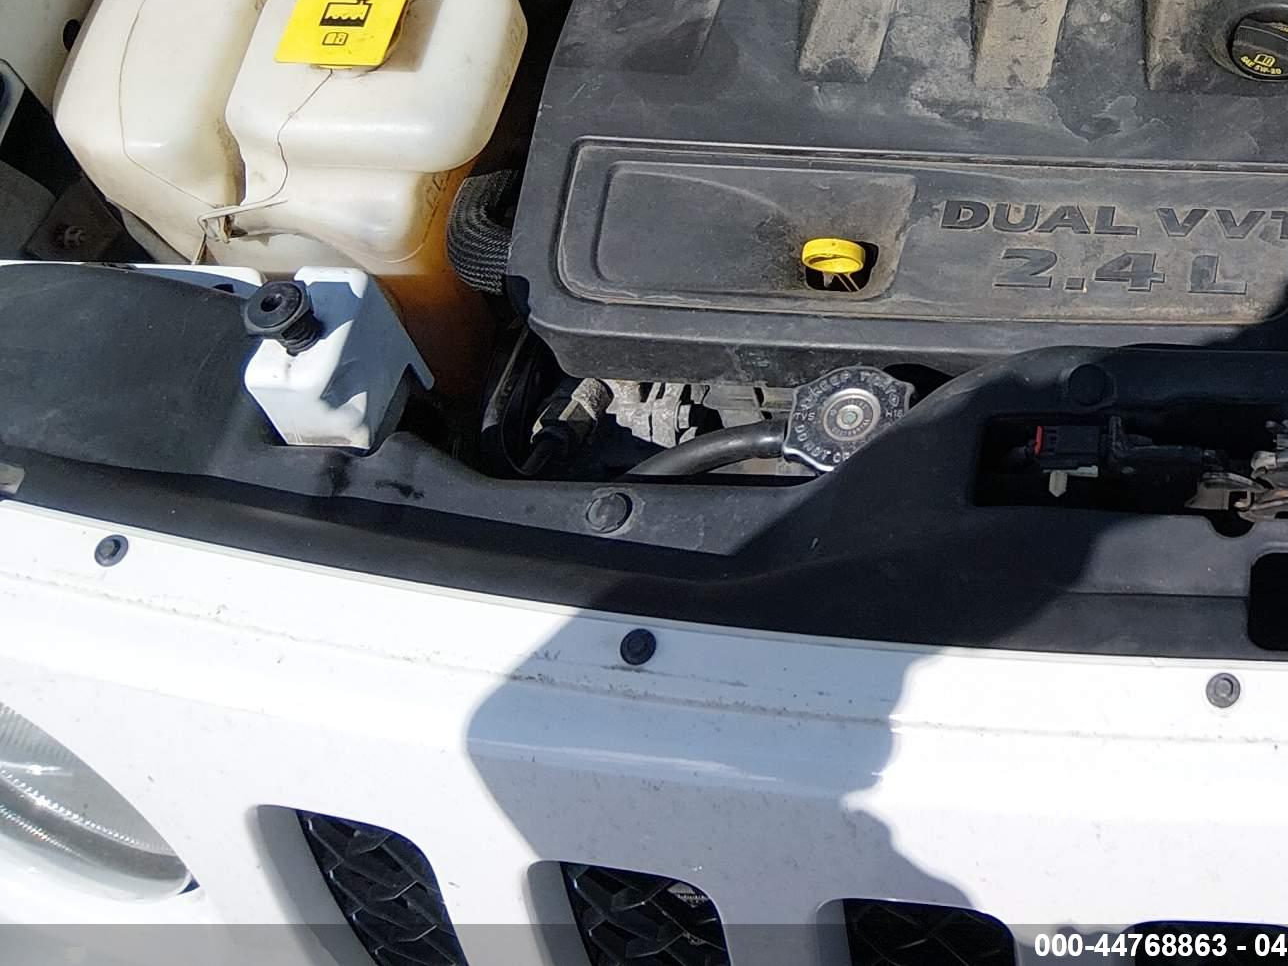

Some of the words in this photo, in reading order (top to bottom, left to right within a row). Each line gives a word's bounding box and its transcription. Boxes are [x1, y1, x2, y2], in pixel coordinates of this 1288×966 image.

[1240, 55, 1256, 68] SAE
[939, 199, 1139, 237] DUAL
[993, 247, 1167, 293] 2.4
[1187, 254, 1248, 296] L
